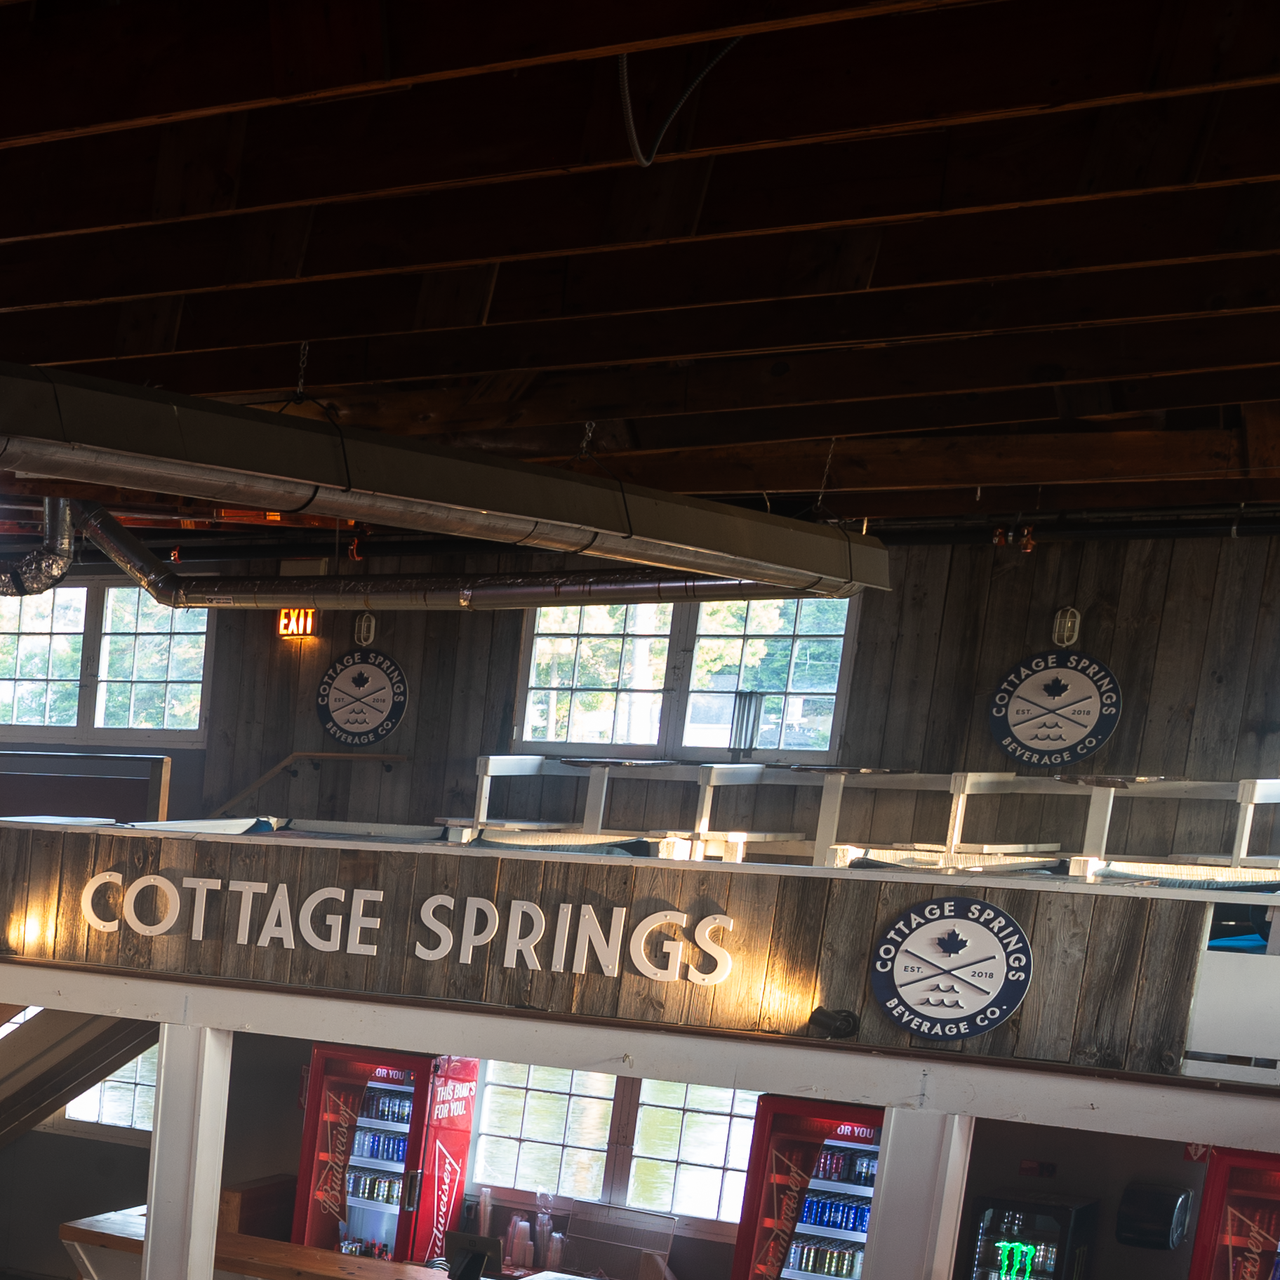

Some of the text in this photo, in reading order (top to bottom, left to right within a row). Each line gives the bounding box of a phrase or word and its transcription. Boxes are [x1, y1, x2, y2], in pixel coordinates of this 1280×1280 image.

[278, 608, 316, 635] EXIT
[318, 652, 405, 705] COTTAGE SPRINGS
[992, 654, 1117, 717] COTTAGE SPRINGS
[325, 721, 375, 744] BEVERAGE
[1001, 735, 1102, 765] BEVERAGE CO.
[81, 871, 734, 986] COTTAGE SPRINGS
[875, 901, 1027, 982] COTTAGE SPRINGS
[903, 965, 924, 974] EST.
[970, 970, 994, 979] 2018
[886, 998, 1007, 1036] BEVERAGE CO.
[371, 1067, 387, 1078] OR
[388, 1069, 405, 1080] YOU
[436, 1080, 477, 1101] THIS BUD'S
[433, 1100, 467, 1120] FOR YOU.
[853, 1126, 874, 1139] YOU
[320, 1104, 352, 1215] Budweiser
[432, 1157, 453, 1258] udweiser
